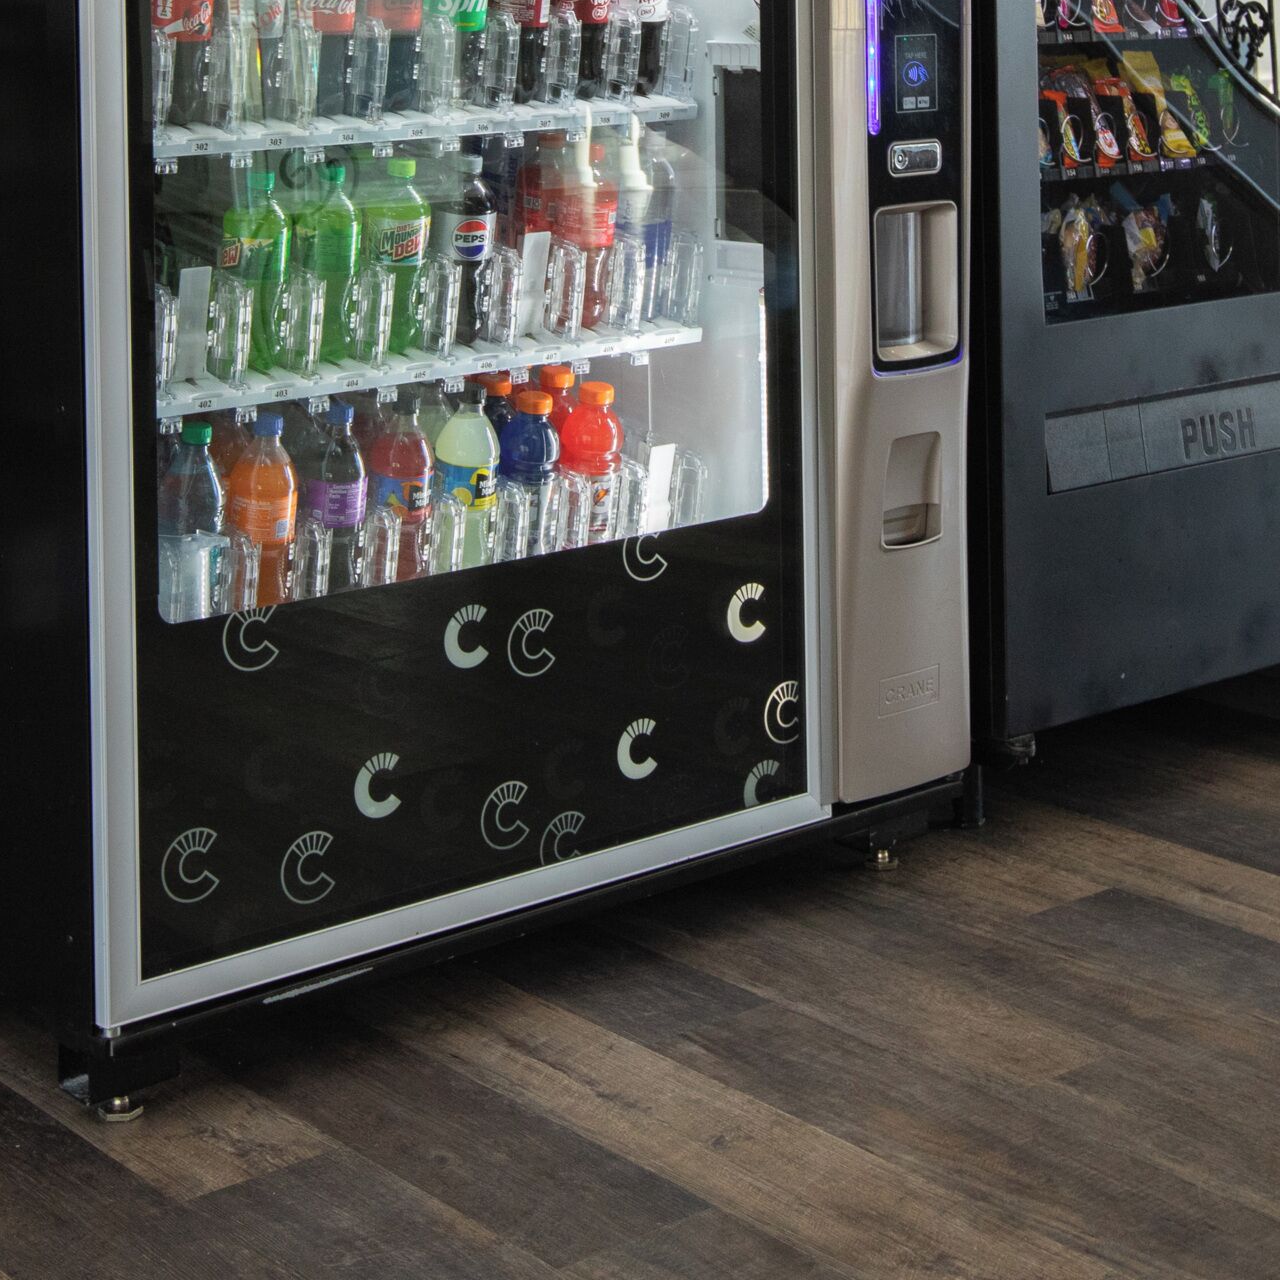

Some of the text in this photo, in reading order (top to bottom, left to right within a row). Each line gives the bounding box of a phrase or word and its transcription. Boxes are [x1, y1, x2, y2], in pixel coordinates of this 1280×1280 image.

[658, 111, 671, 120] 309
[539, 119, 552, 128] 307
[599, 116, 611, 125] 308
[477, 123, 489, 132] 306
[411, 128, 423, 137] 305
[340, 133, 355, 142] 304
[194, 142, 209, 151] 302
[268, 138, 282, 147] 303
[396, 223, 411, 233] DIET
[602, 344, 615, 353] 408
[544, 352, 558, 361] 407
[480, 360, 493, 369] 406
[413, 371, 427, 380] 405
[345, 379, 359, 388] 404
[274, 389, 288, 399] 403
[198, 399, 212, 409] 402
[1182, 407, 1257, 460] PUSH
[885, 677, 935, 705] CRANE
